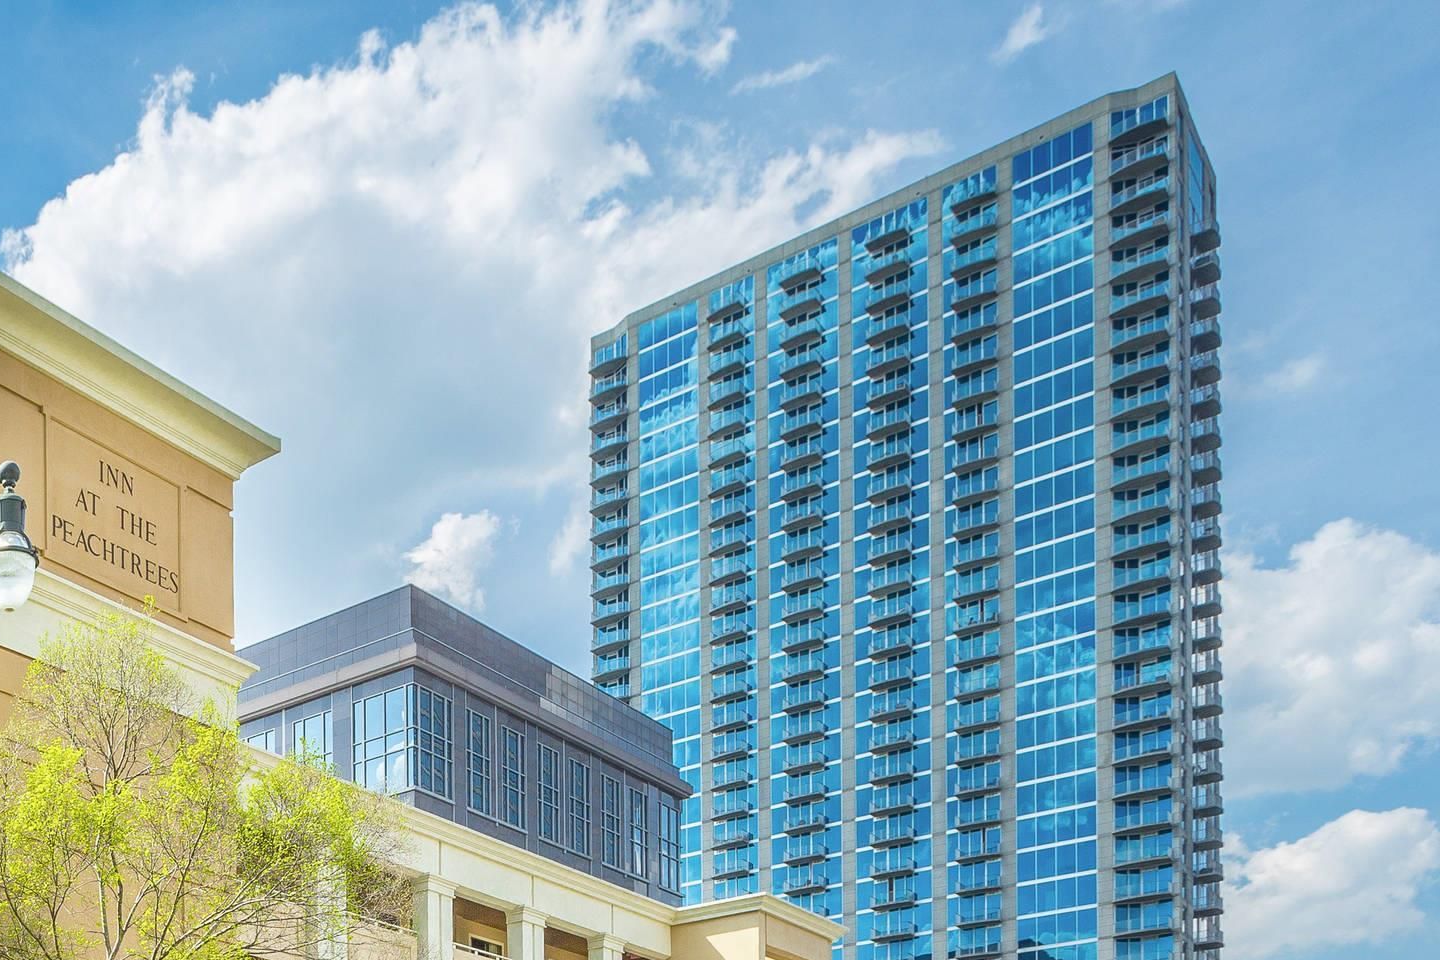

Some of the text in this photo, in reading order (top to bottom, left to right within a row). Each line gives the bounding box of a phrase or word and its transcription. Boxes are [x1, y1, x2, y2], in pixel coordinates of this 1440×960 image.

[98, 460, 134, 496] INN
[75, 488, 157, 546] AT THE
[52, 514, 179, 594] PEACHTREES
